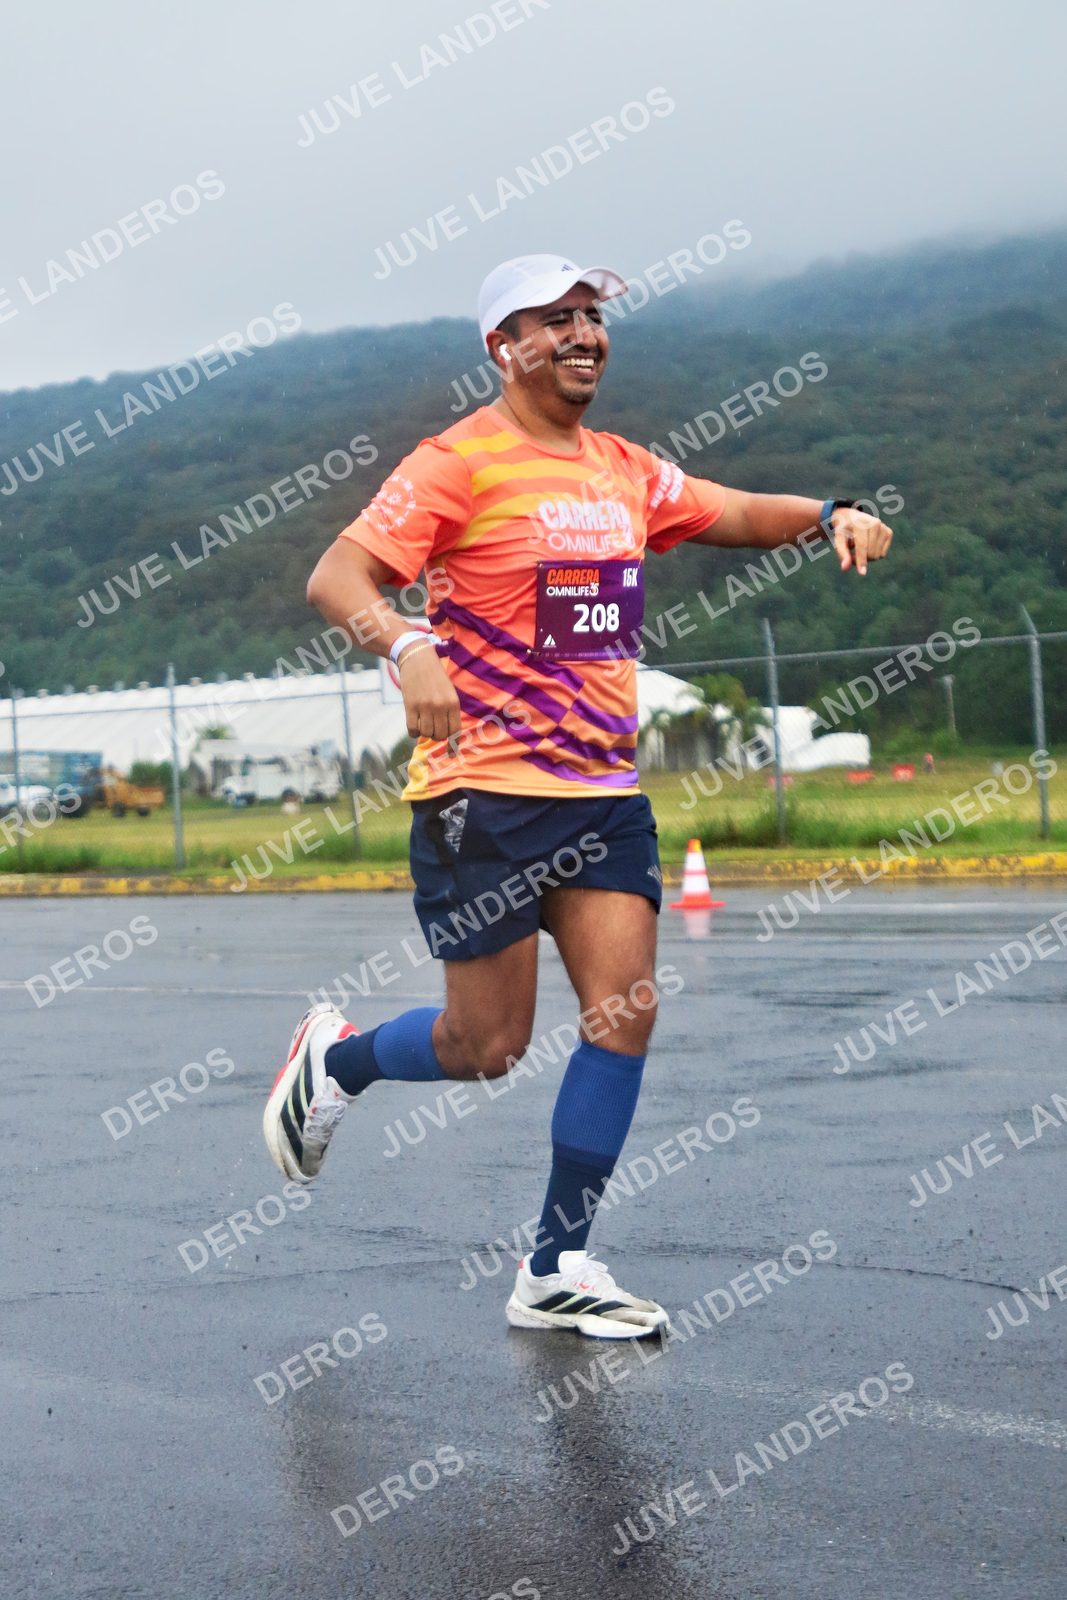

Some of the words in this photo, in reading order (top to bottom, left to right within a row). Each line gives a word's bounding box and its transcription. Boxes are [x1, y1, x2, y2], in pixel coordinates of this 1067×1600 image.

[539, 500, 631, 530] CARRERA
[547, 569, 600, 585] CARRERA
[546, 586, 589, 597] OMNILIFE
[572, 603, 620, 633] 208
